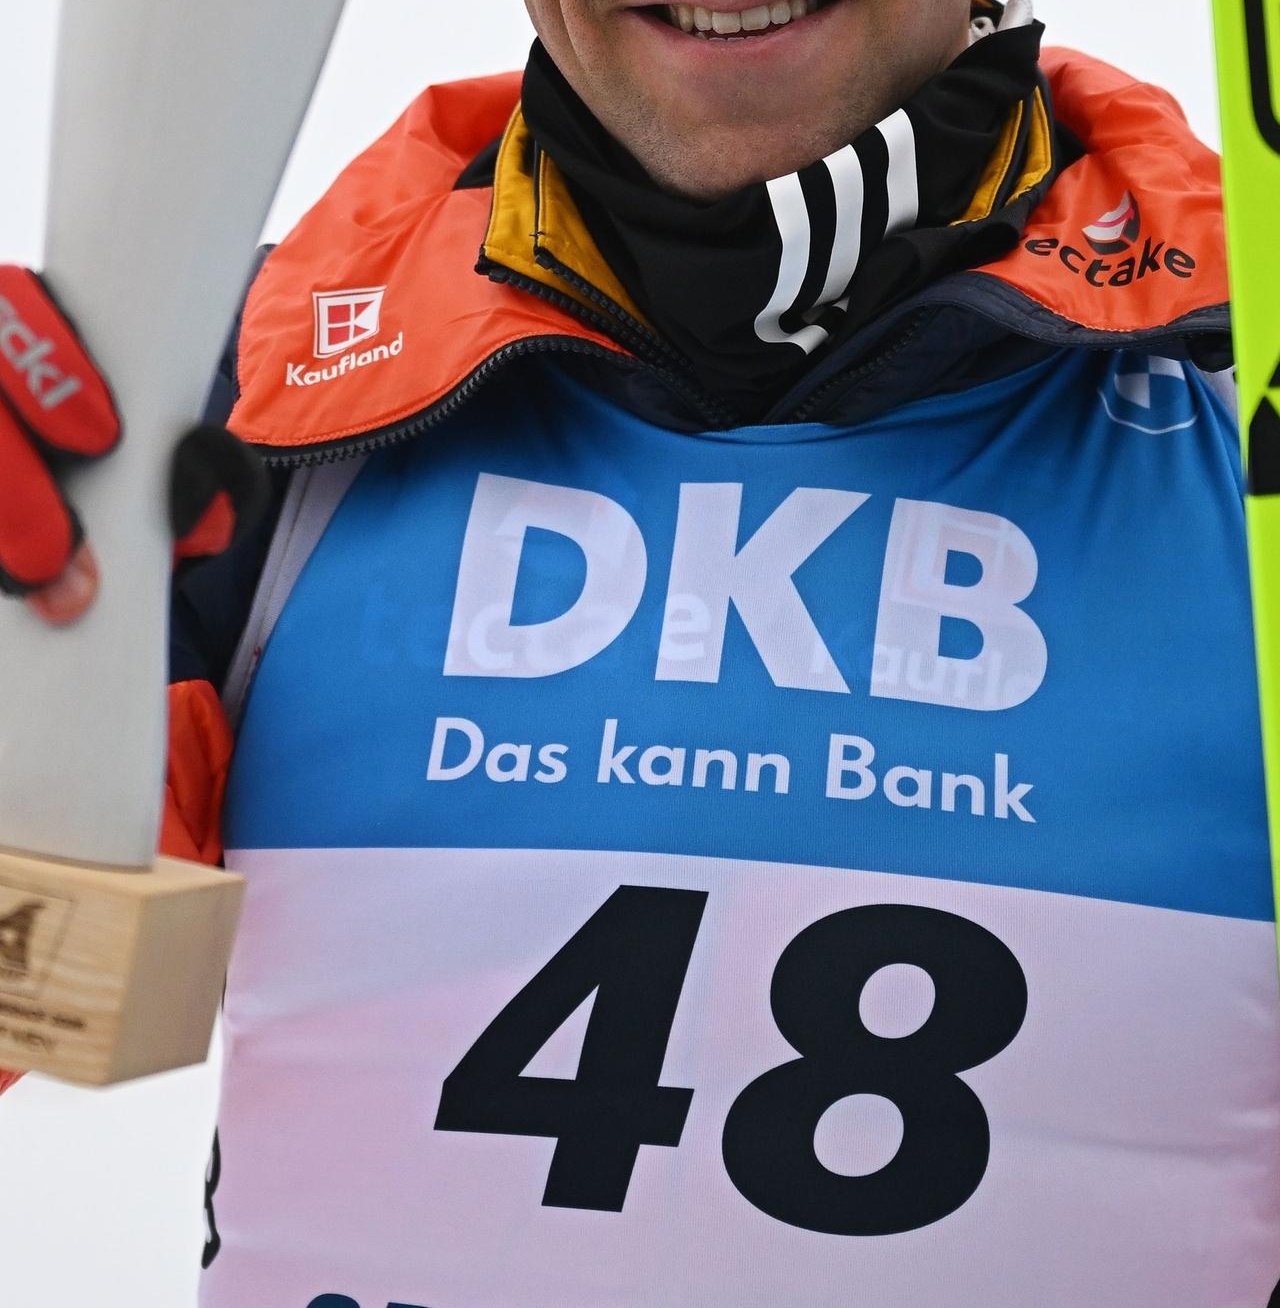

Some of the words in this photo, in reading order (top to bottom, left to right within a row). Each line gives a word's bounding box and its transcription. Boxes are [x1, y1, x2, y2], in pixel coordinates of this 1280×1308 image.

[1024, 236, 1197, 288] ectake
[285, 332, 403, 386] Kaufland
[443, 471, 1048, 712] DKB
[426, 717, 569, 783] Das
[596, 718, 792, 794] kann
[825, 733, 1037, 823] Bank
[433, 884, 1029, 1238] 48
